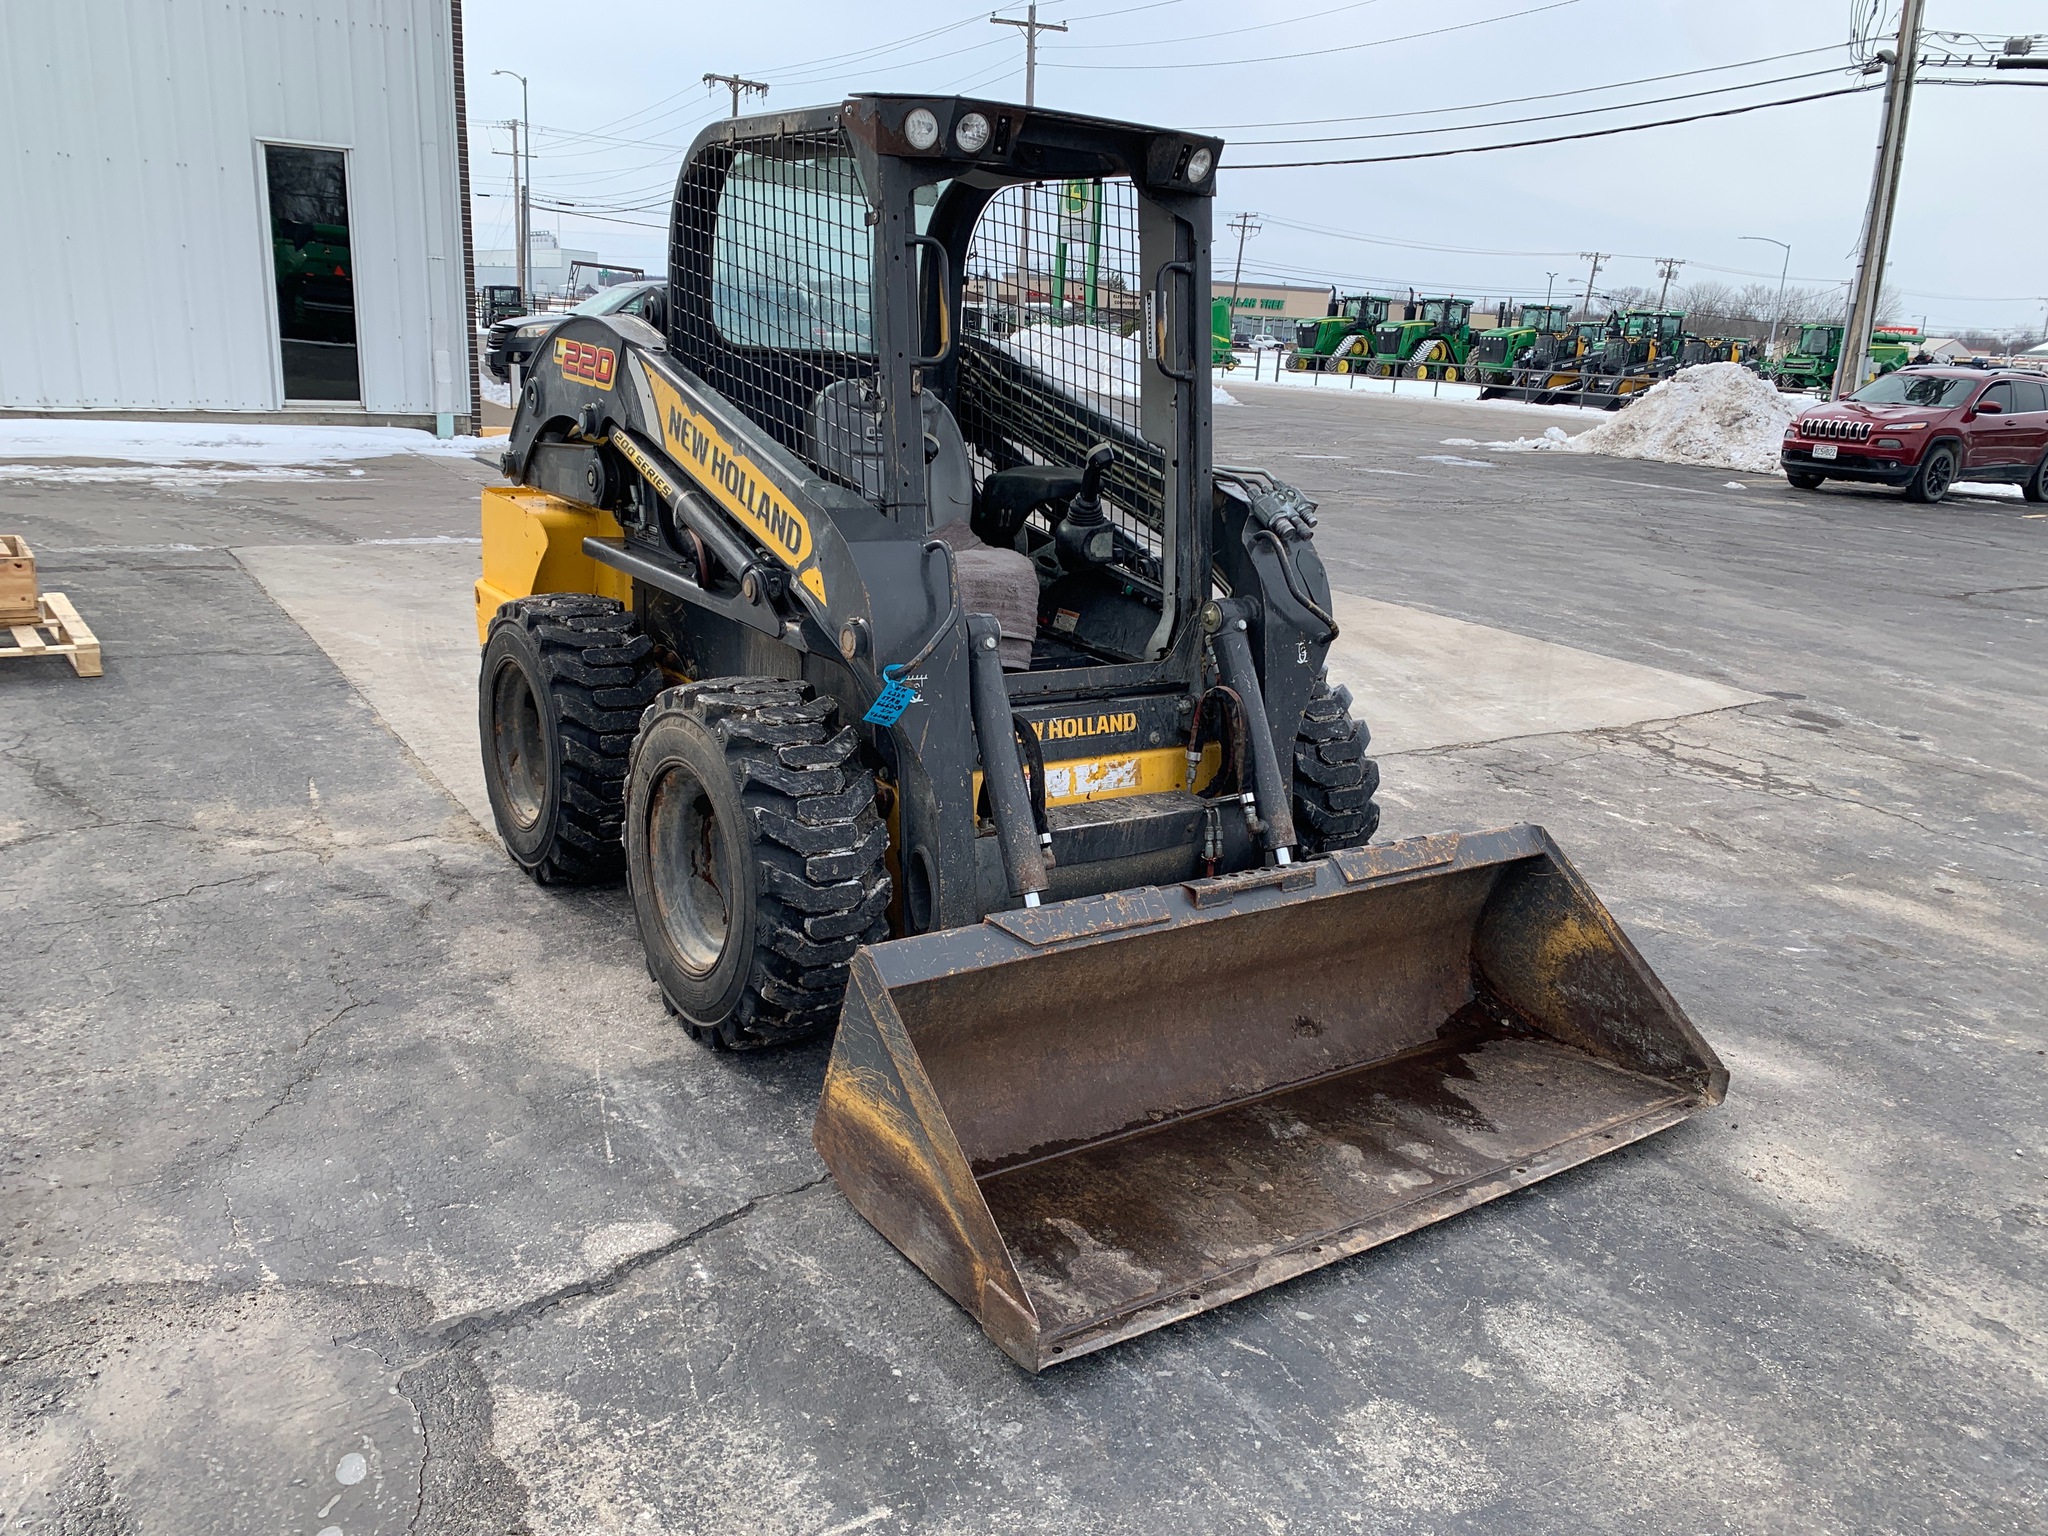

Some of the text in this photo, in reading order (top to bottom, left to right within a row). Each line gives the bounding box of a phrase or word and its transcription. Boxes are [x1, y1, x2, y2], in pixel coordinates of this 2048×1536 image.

[1218, 296, 1285, 310] DOLAR TREE
[554, 340, 615, 386] L220
[614, 431, 672, 496] 200 SERIES
[668, 408, 801, 556] NEW HOLLAND
[1049, 712, 1137, 740] HOLLAND
